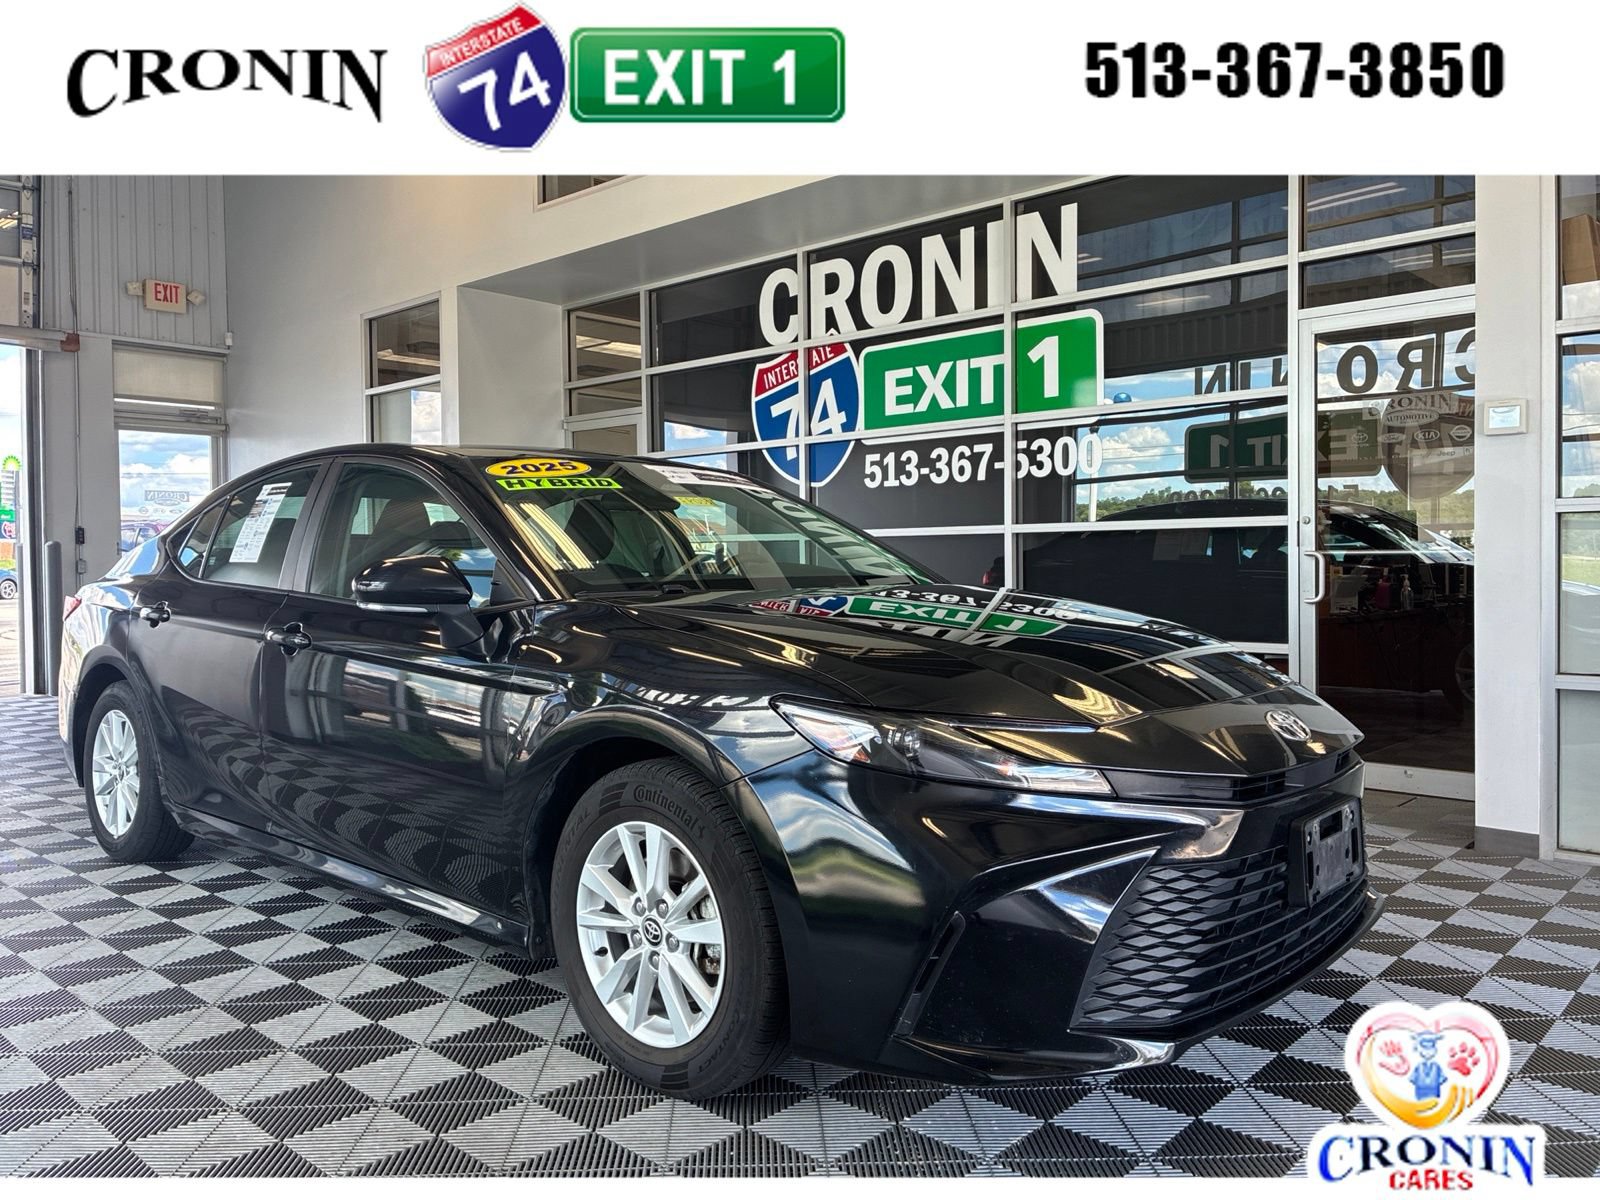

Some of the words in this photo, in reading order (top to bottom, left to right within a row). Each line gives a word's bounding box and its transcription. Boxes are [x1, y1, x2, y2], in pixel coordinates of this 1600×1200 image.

[154, 282, 180, 305] EXIT
[759, 202, 1078, 346] CRONIN
[763, 346, 835, 390] INTERATE
[884, 354, 1005, 417] EXIT
[1027, 336, 1059, 398] 1
[771, 378, 847, 461] 74
[500, 461, 578, 475] 2025
[506, 478, 615, 489] HYBRID
[863, 433, 1103, 488] 513-367-5300
[633, 785, 698, 831] Continental
